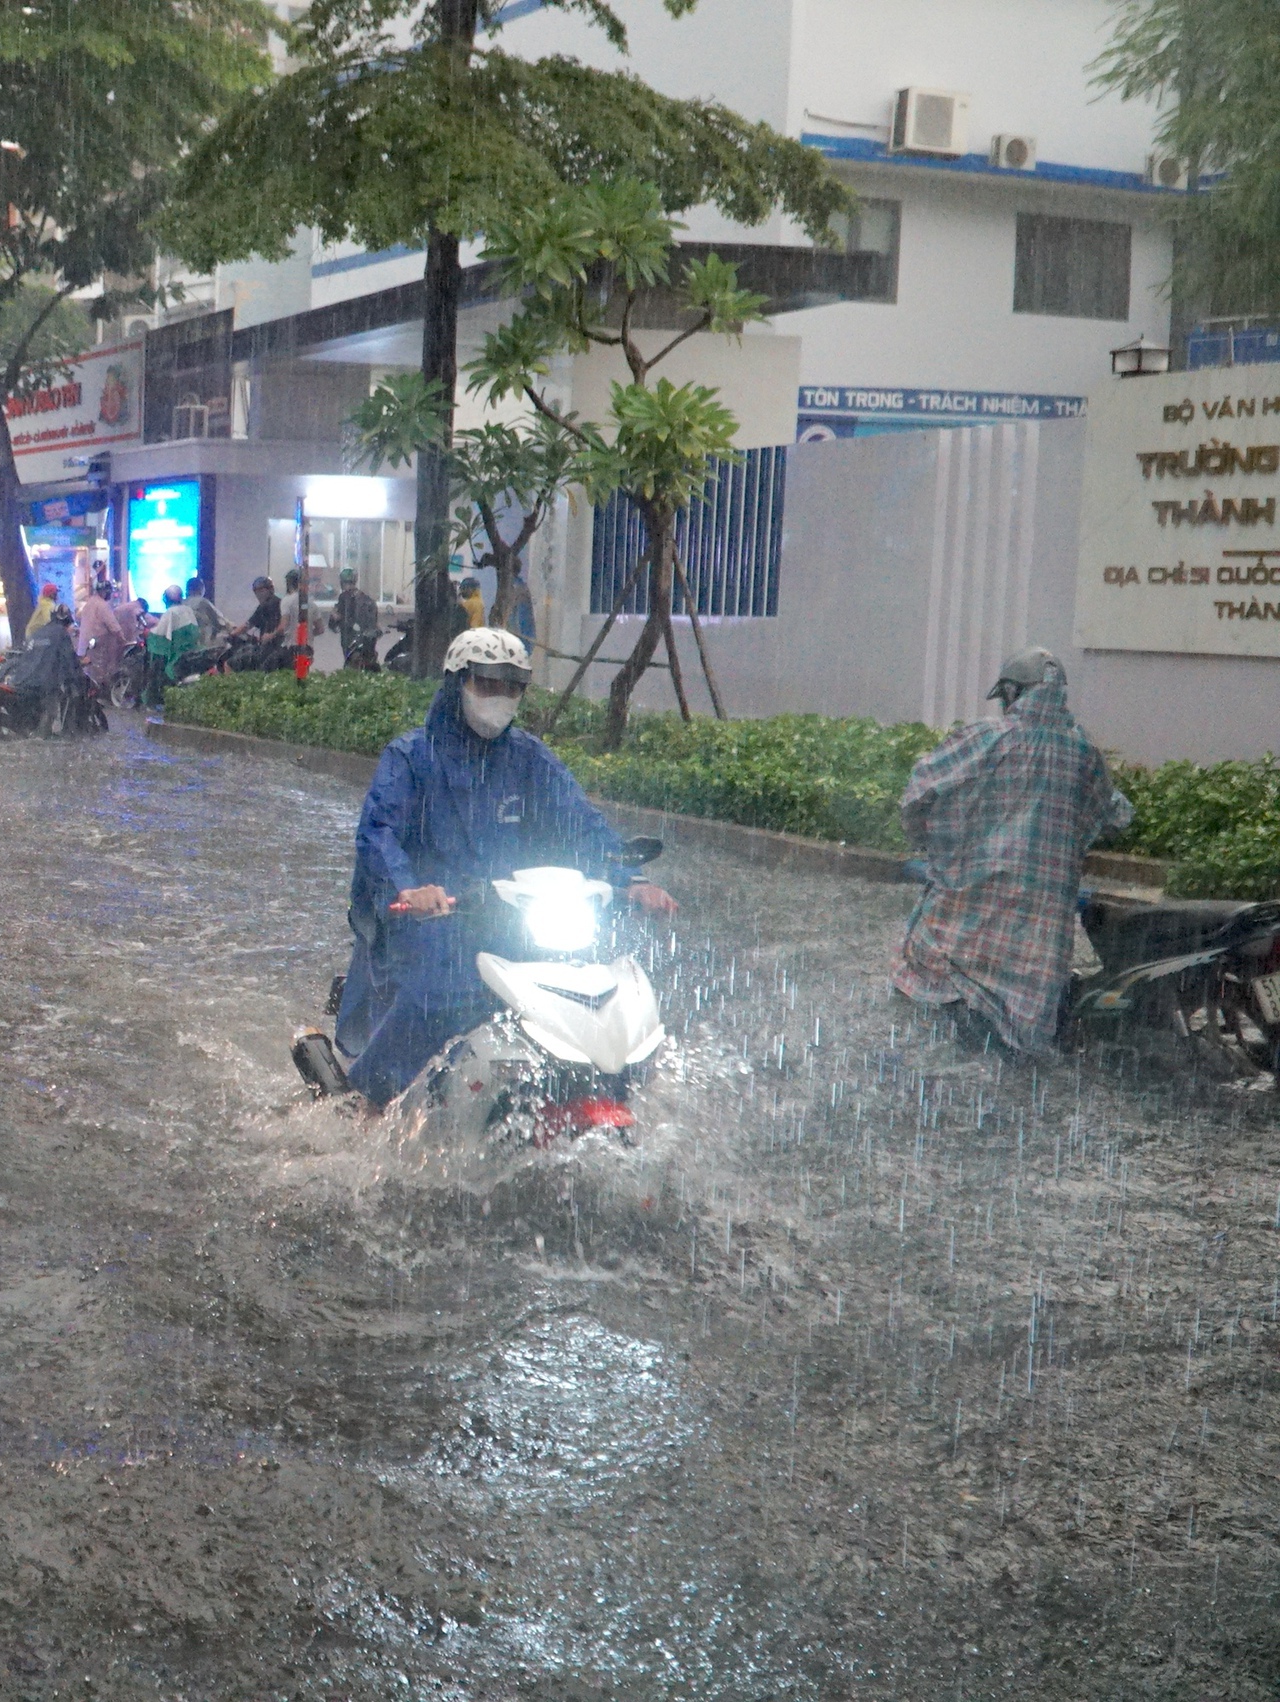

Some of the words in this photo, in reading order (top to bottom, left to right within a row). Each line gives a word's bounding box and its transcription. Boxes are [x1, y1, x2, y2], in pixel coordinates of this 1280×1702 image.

[804, 387, 839, 407] TÔN
[845, 391, 903, 411] TRỌNG
[920, 390, 976, 412] TRÁCH
[983, 394, 1039, 418] NHIỆM
[1136, 437, 1280, 479] TRƯỜNG
